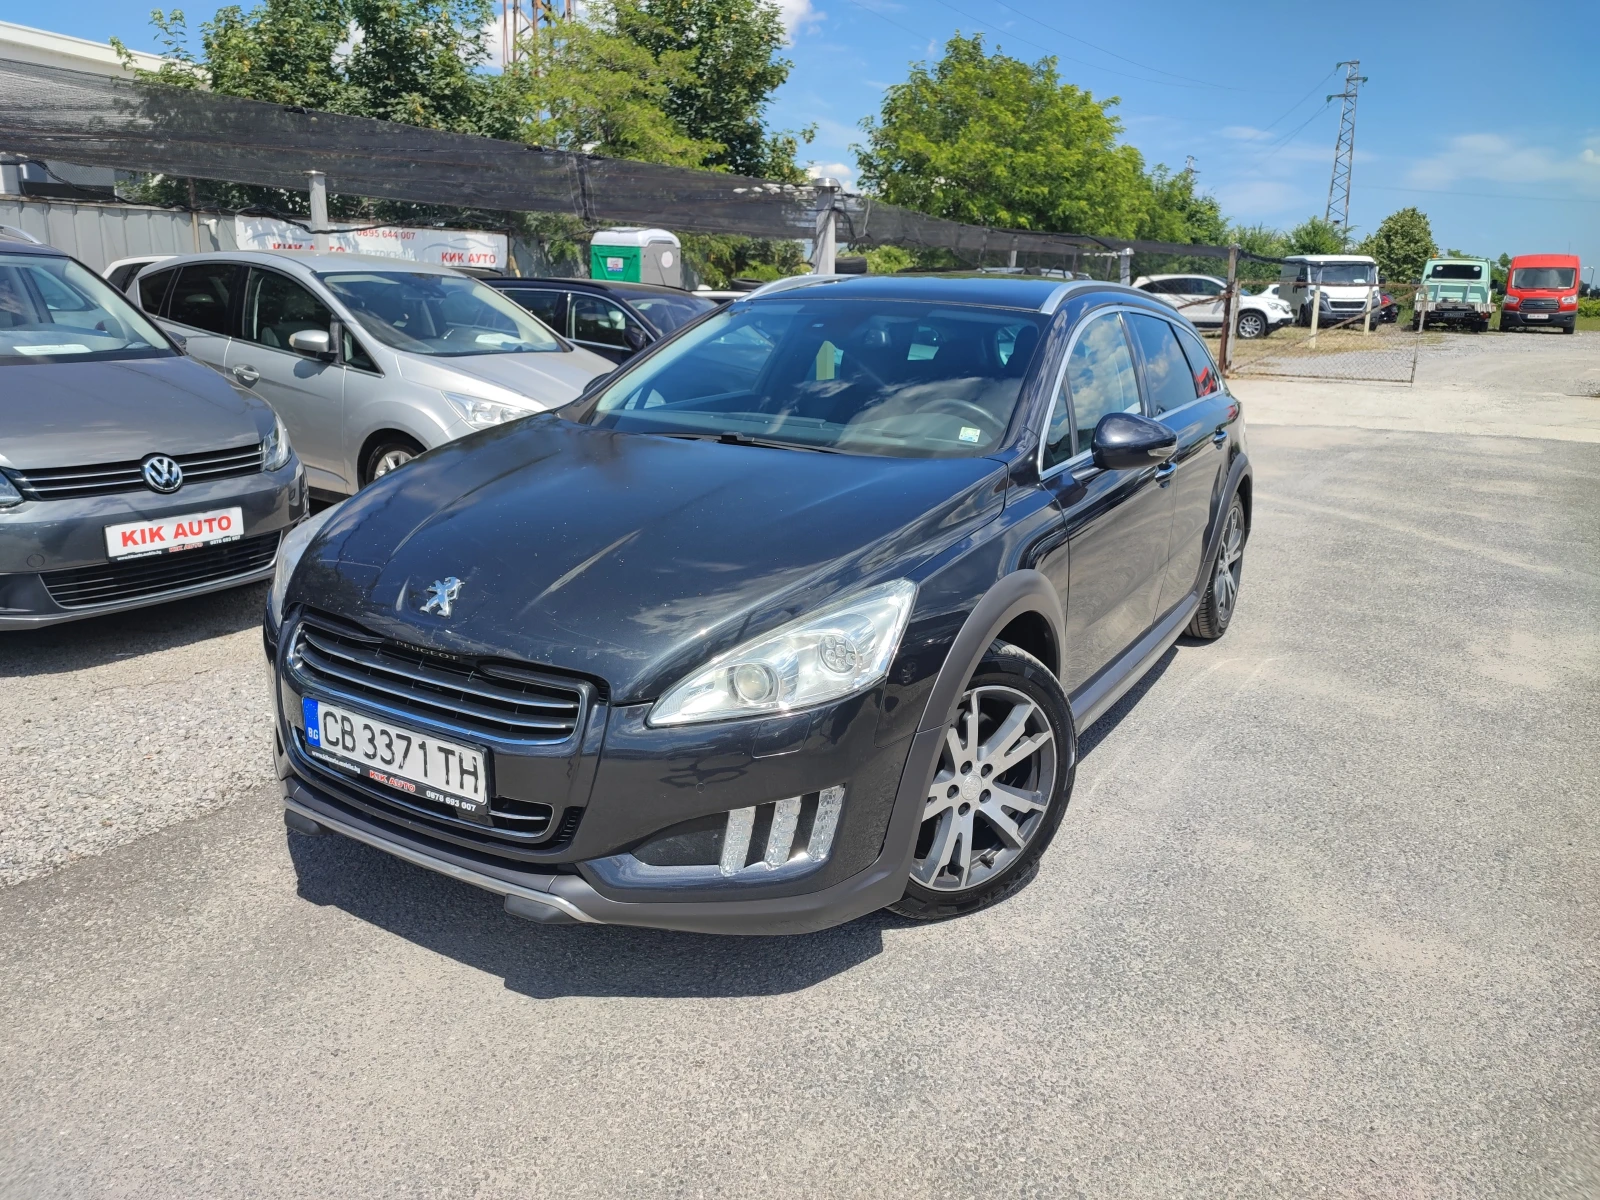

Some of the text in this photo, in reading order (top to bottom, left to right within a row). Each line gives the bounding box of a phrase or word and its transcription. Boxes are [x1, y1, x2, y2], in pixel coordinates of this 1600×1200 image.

[382, 229, 398, 240] 644
[401, 231, 416, 241] 007
[441, 252, 496, 264] КИК АУТО
[121, 515, 232, 547] KIK AUTO
[396, 640, 459, 661] PEUGEOT
[307, 727, 319, 740] BG
[323, 711, 356, 753] CB
[362, 723, 428, 778] 3371
[437, 745, 479, 794] TH
[369, 769, 416, 793] KIK AUTO
[425, 790, 477, 812] 0878 693 007
